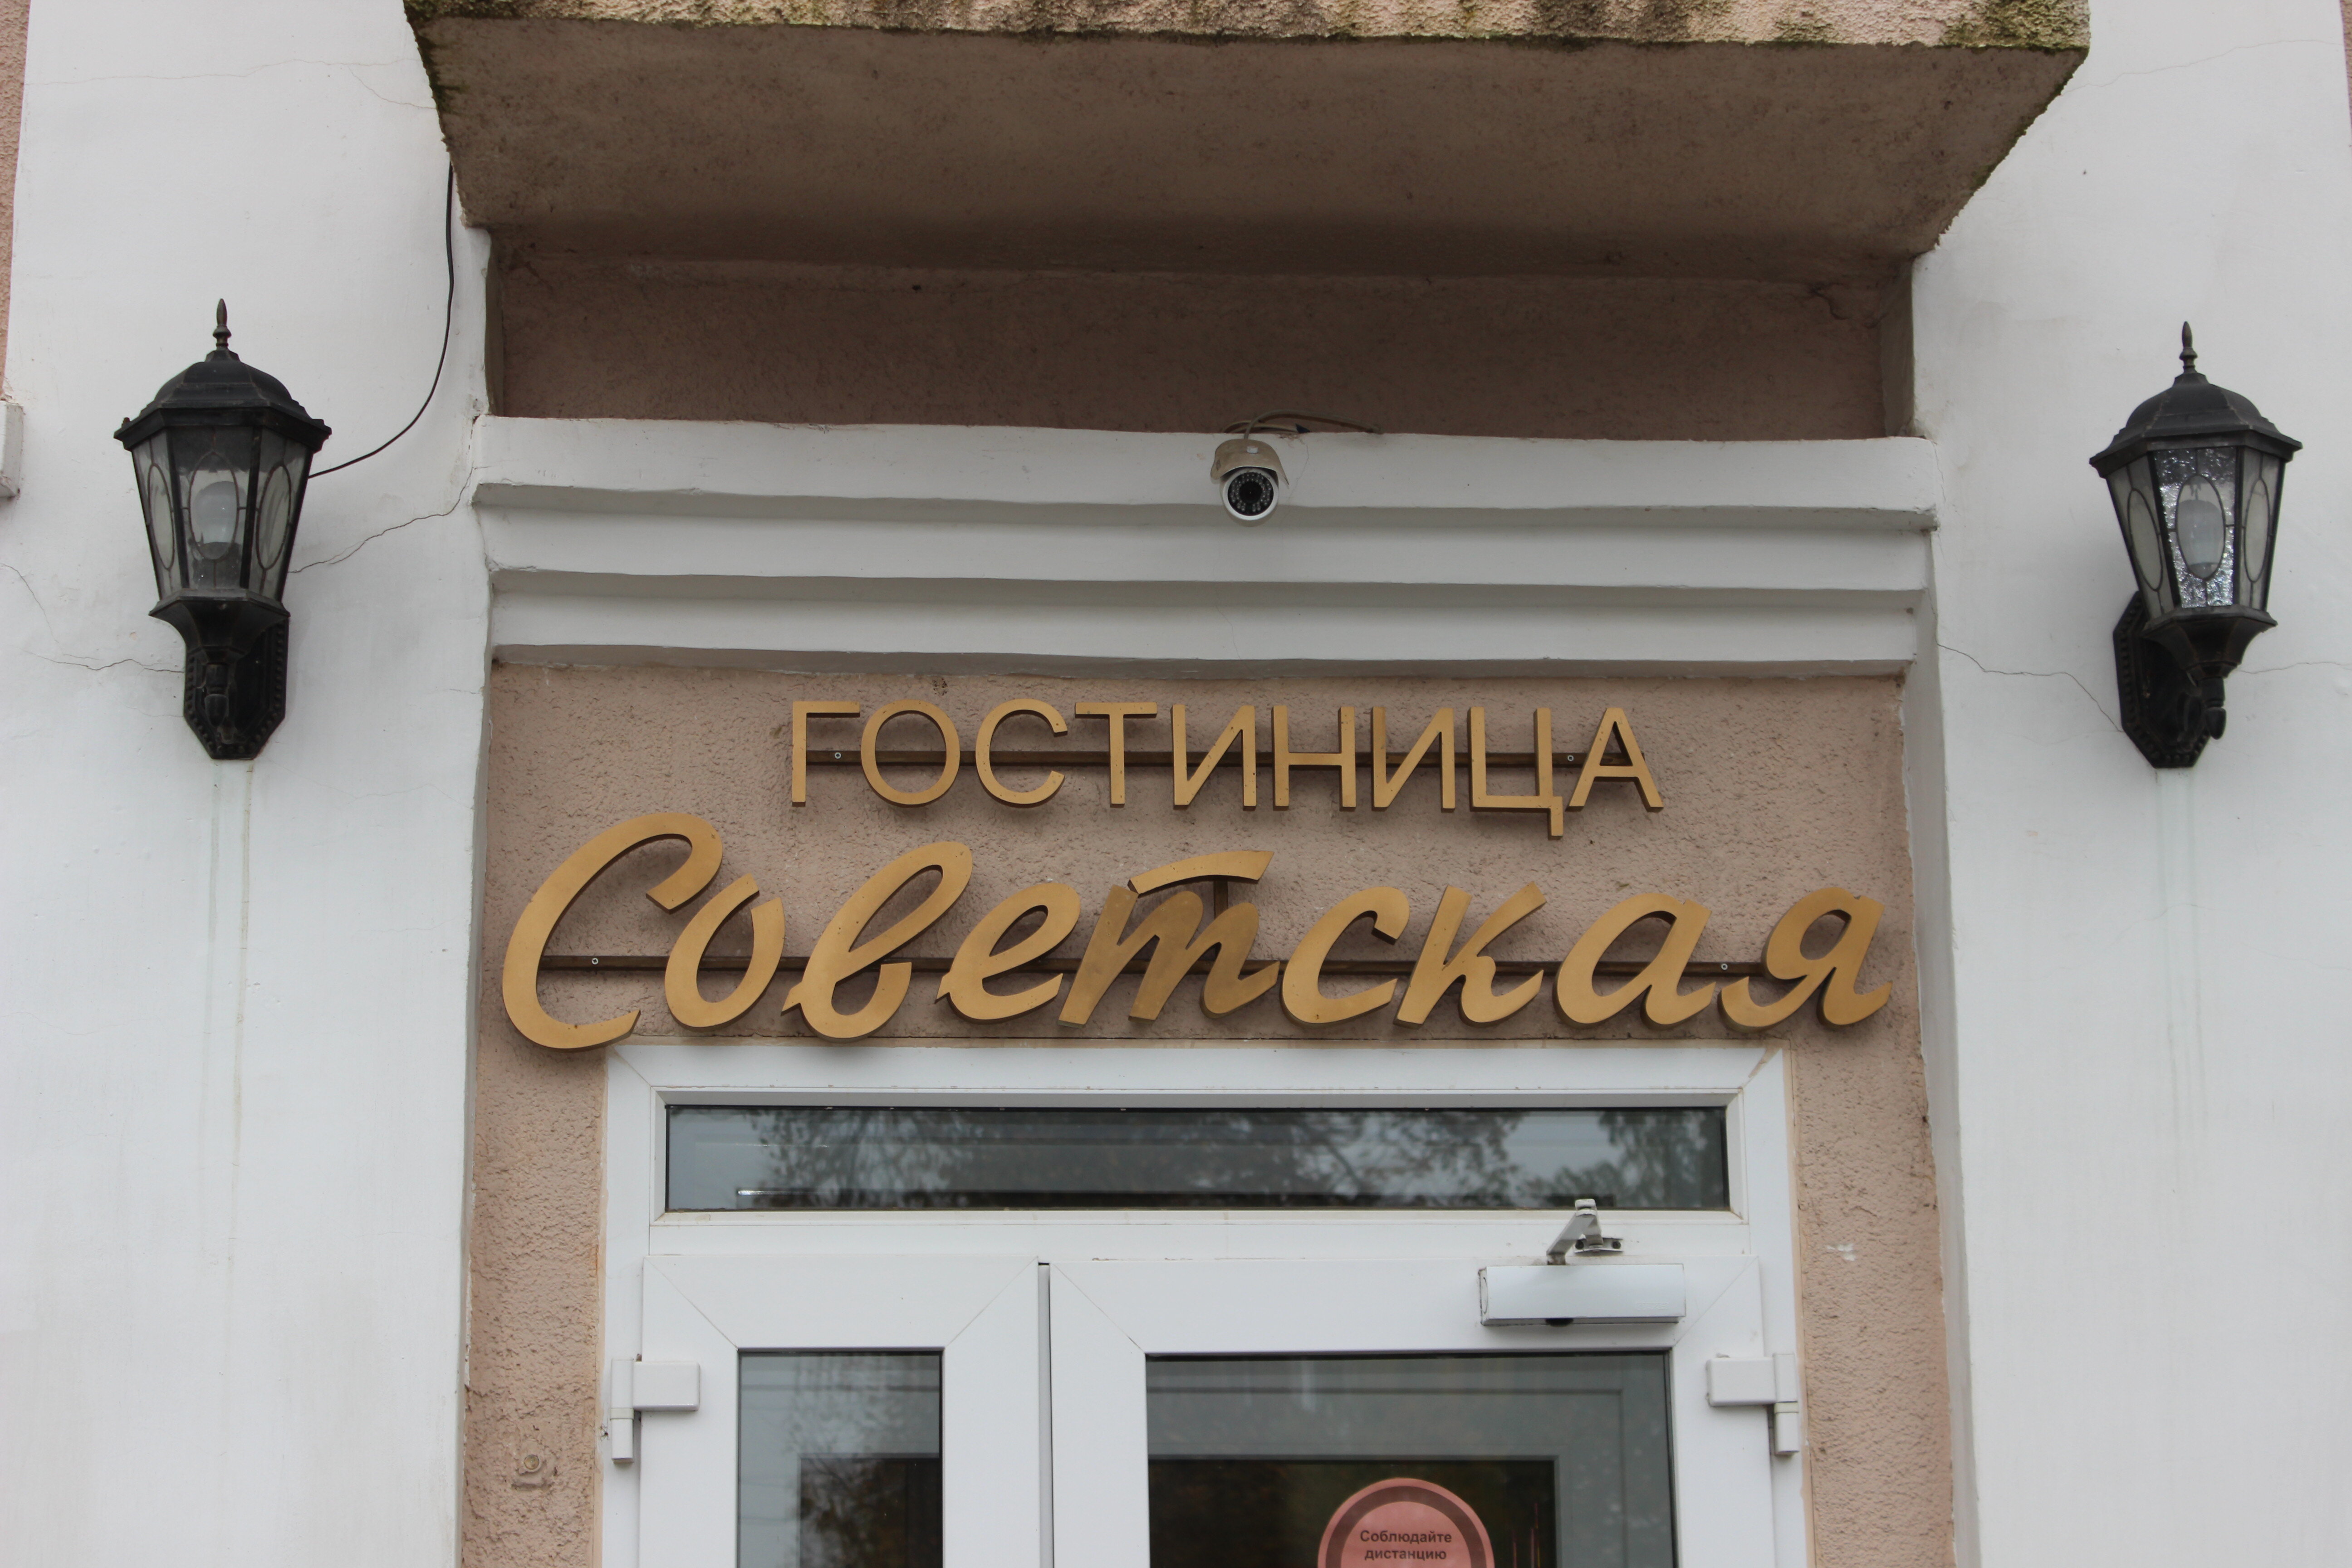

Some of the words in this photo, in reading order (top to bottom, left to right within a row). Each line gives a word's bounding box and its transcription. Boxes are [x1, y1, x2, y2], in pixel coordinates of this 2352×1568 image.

[791, 699, 1664, 838] ГОСТИНИЦА
[501, 812, 1893, 1050] Советская
[1360, 1530, 1452, 1544] Соблюдайте
[1364, 1550, 1446, 1561] дистанцию
